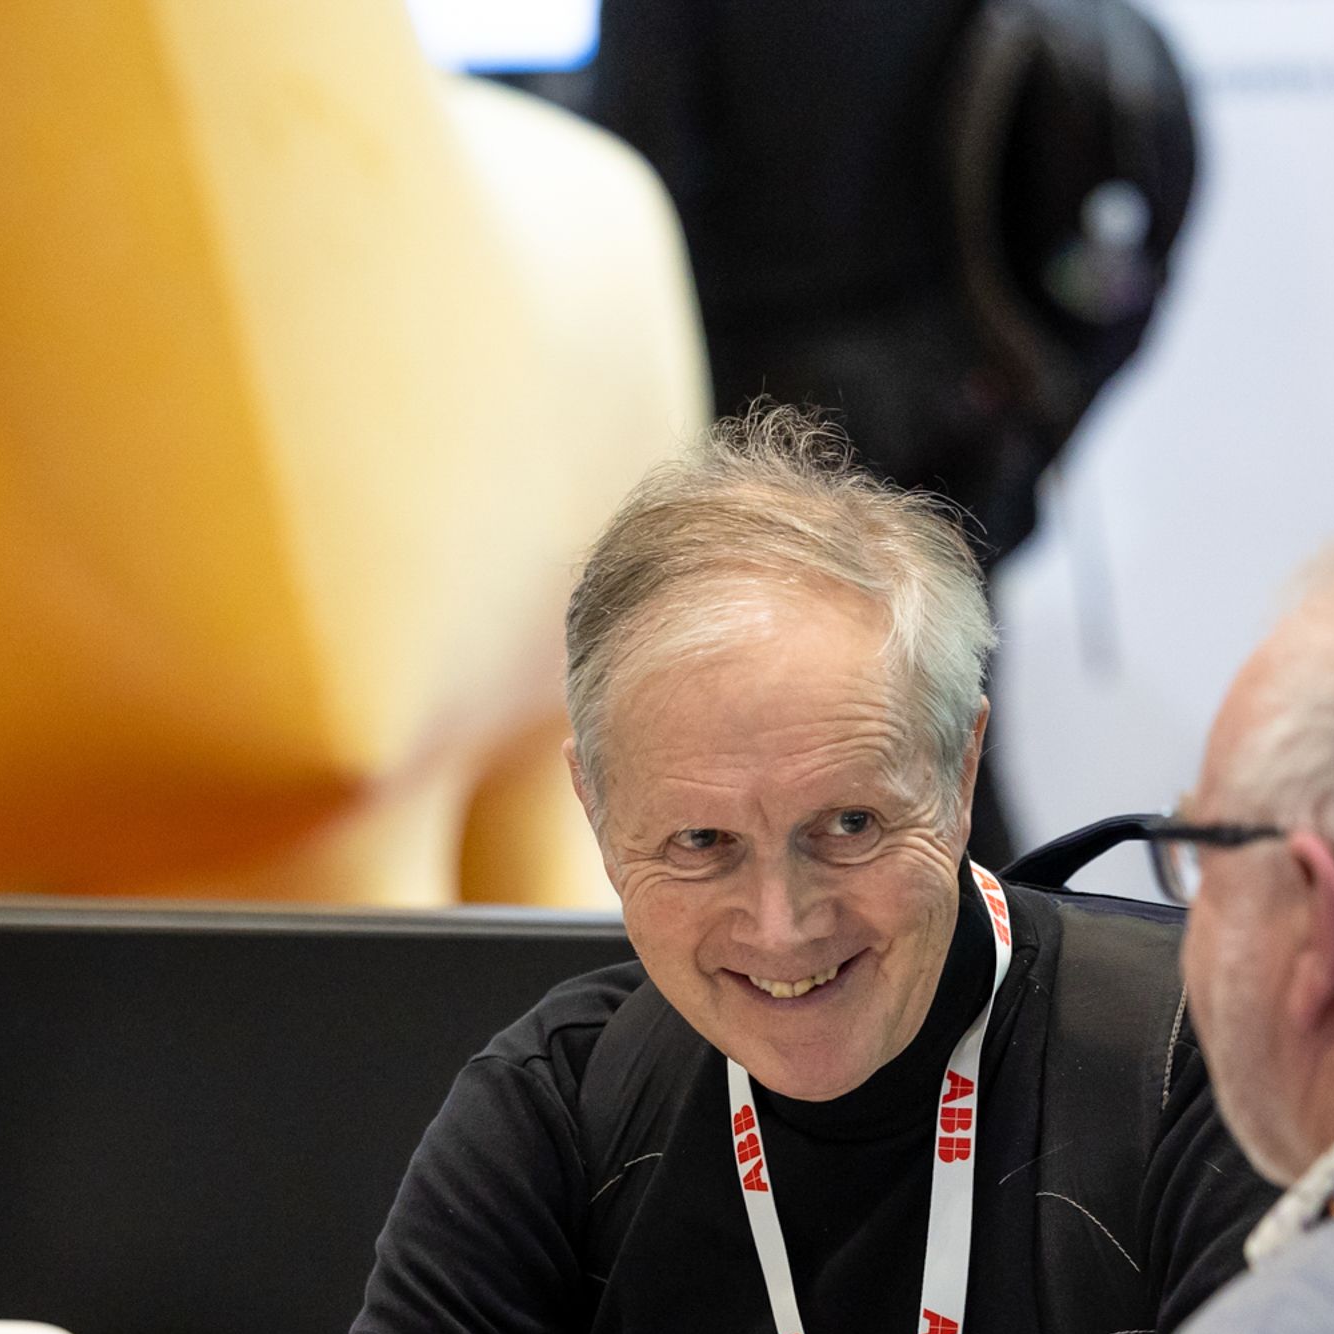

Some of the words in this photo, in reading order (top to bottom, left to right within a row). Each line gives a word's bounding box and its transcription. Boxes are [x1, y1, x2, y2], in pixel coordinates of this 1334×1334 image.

[971, 867, 1011, 946] ABB
[734, 1104, 769, 1193] ABB
[938, 1069, 975, 1164] ABB
